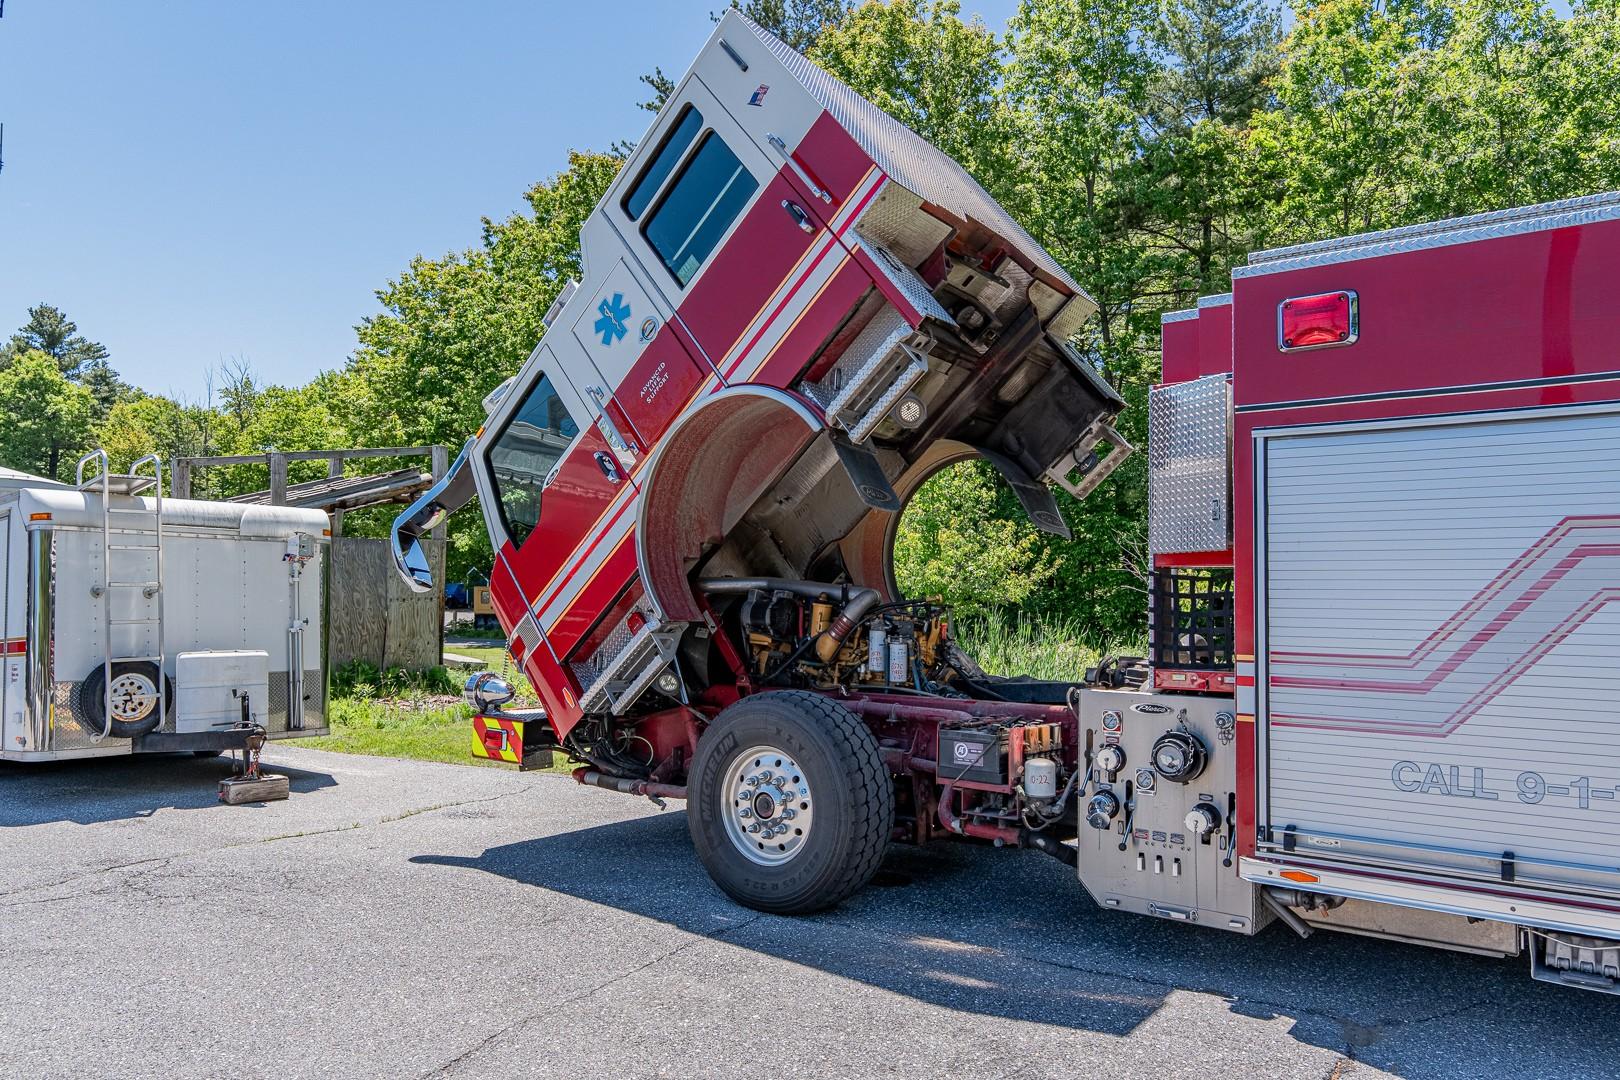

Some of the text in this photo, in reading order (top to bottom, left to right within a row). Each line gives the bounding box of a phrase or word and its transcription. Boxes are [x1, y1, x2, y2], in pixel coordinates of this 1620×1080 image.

[640, 362, 666, 398] ADVANCED
[646, 372, 670, 404] SUPPORT
[649, 376, 661, 392] LIFE
[702, 732, 737, 822] MICHELIN
[1391, 760, 1499, 800] CALL
